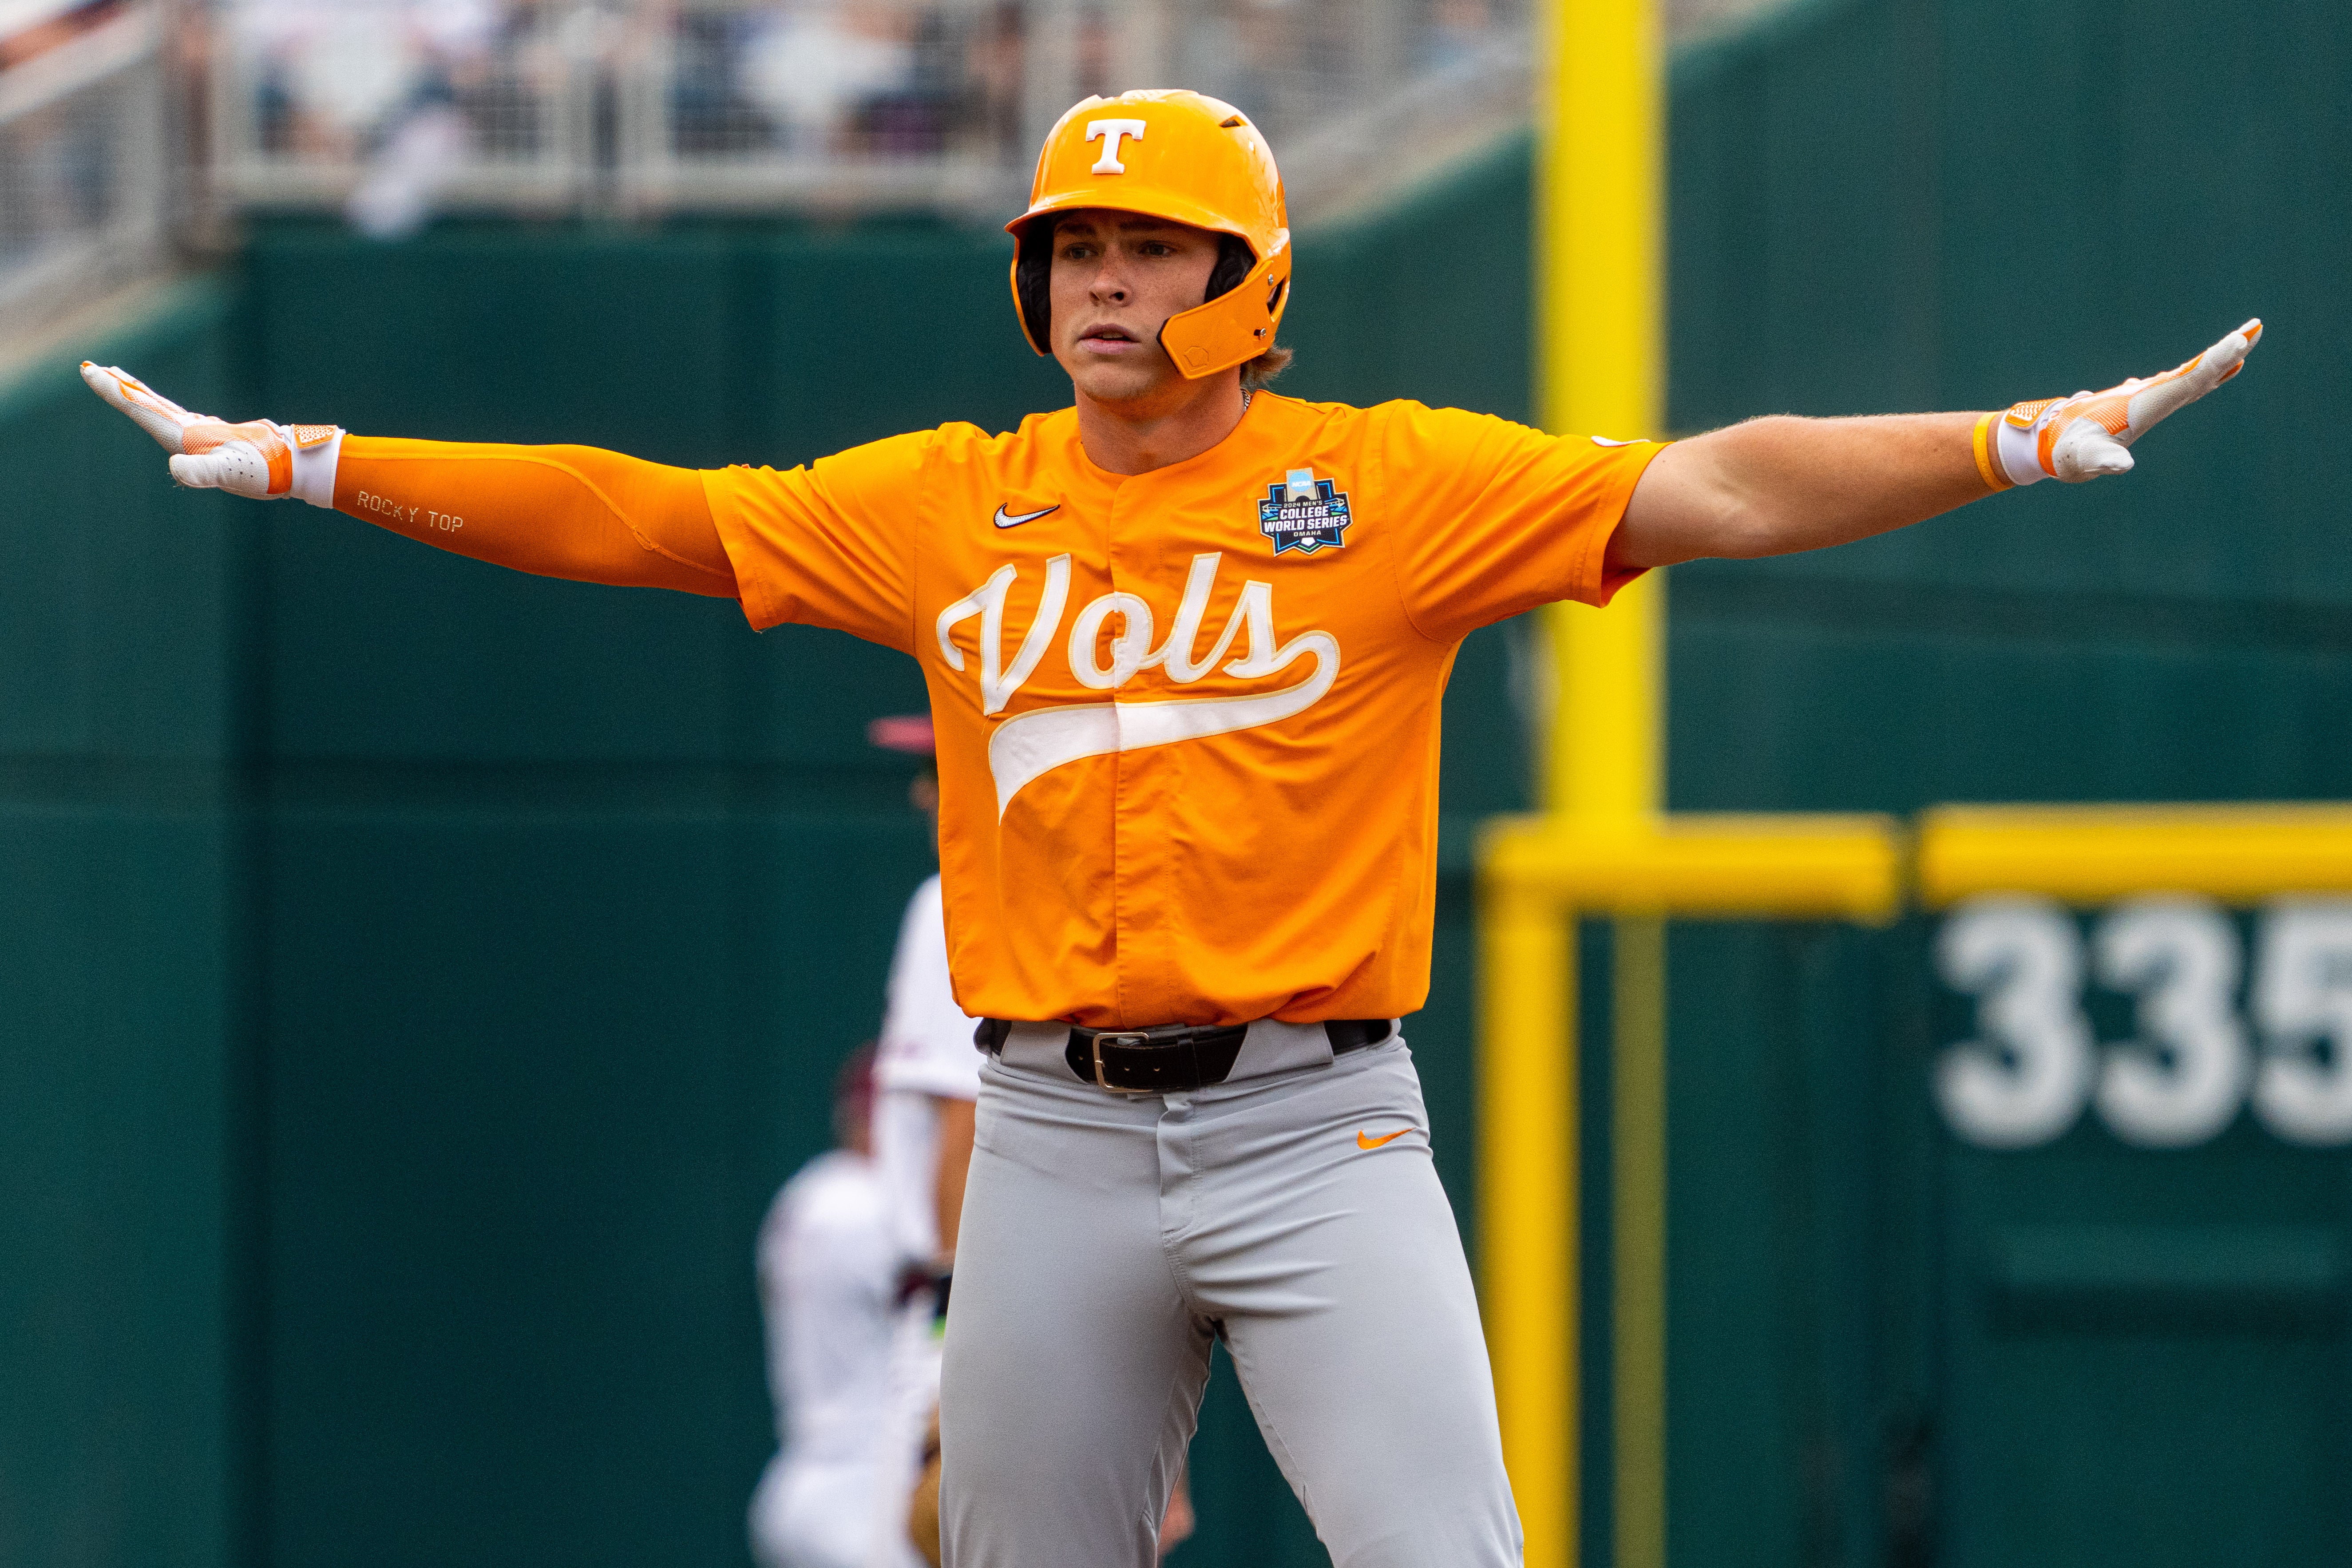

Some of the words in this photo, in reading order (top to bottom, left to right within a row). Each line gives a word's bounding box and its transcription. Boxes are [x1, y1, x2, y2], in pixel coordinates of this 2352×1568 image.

[1085, 118, 1147, 174] T
[357, 490, 419, 523] ROCKY
[428, 511, 463, 532] TOP
[1264, 519, 1305, 532] WORLD
[1307, 515, 1348, 530] SERIES
[1280, 506, 1329, 520] COLLEGE
[936, 553, 1341, 716] Vols
[1933, 891, 2352, 1150] 335
